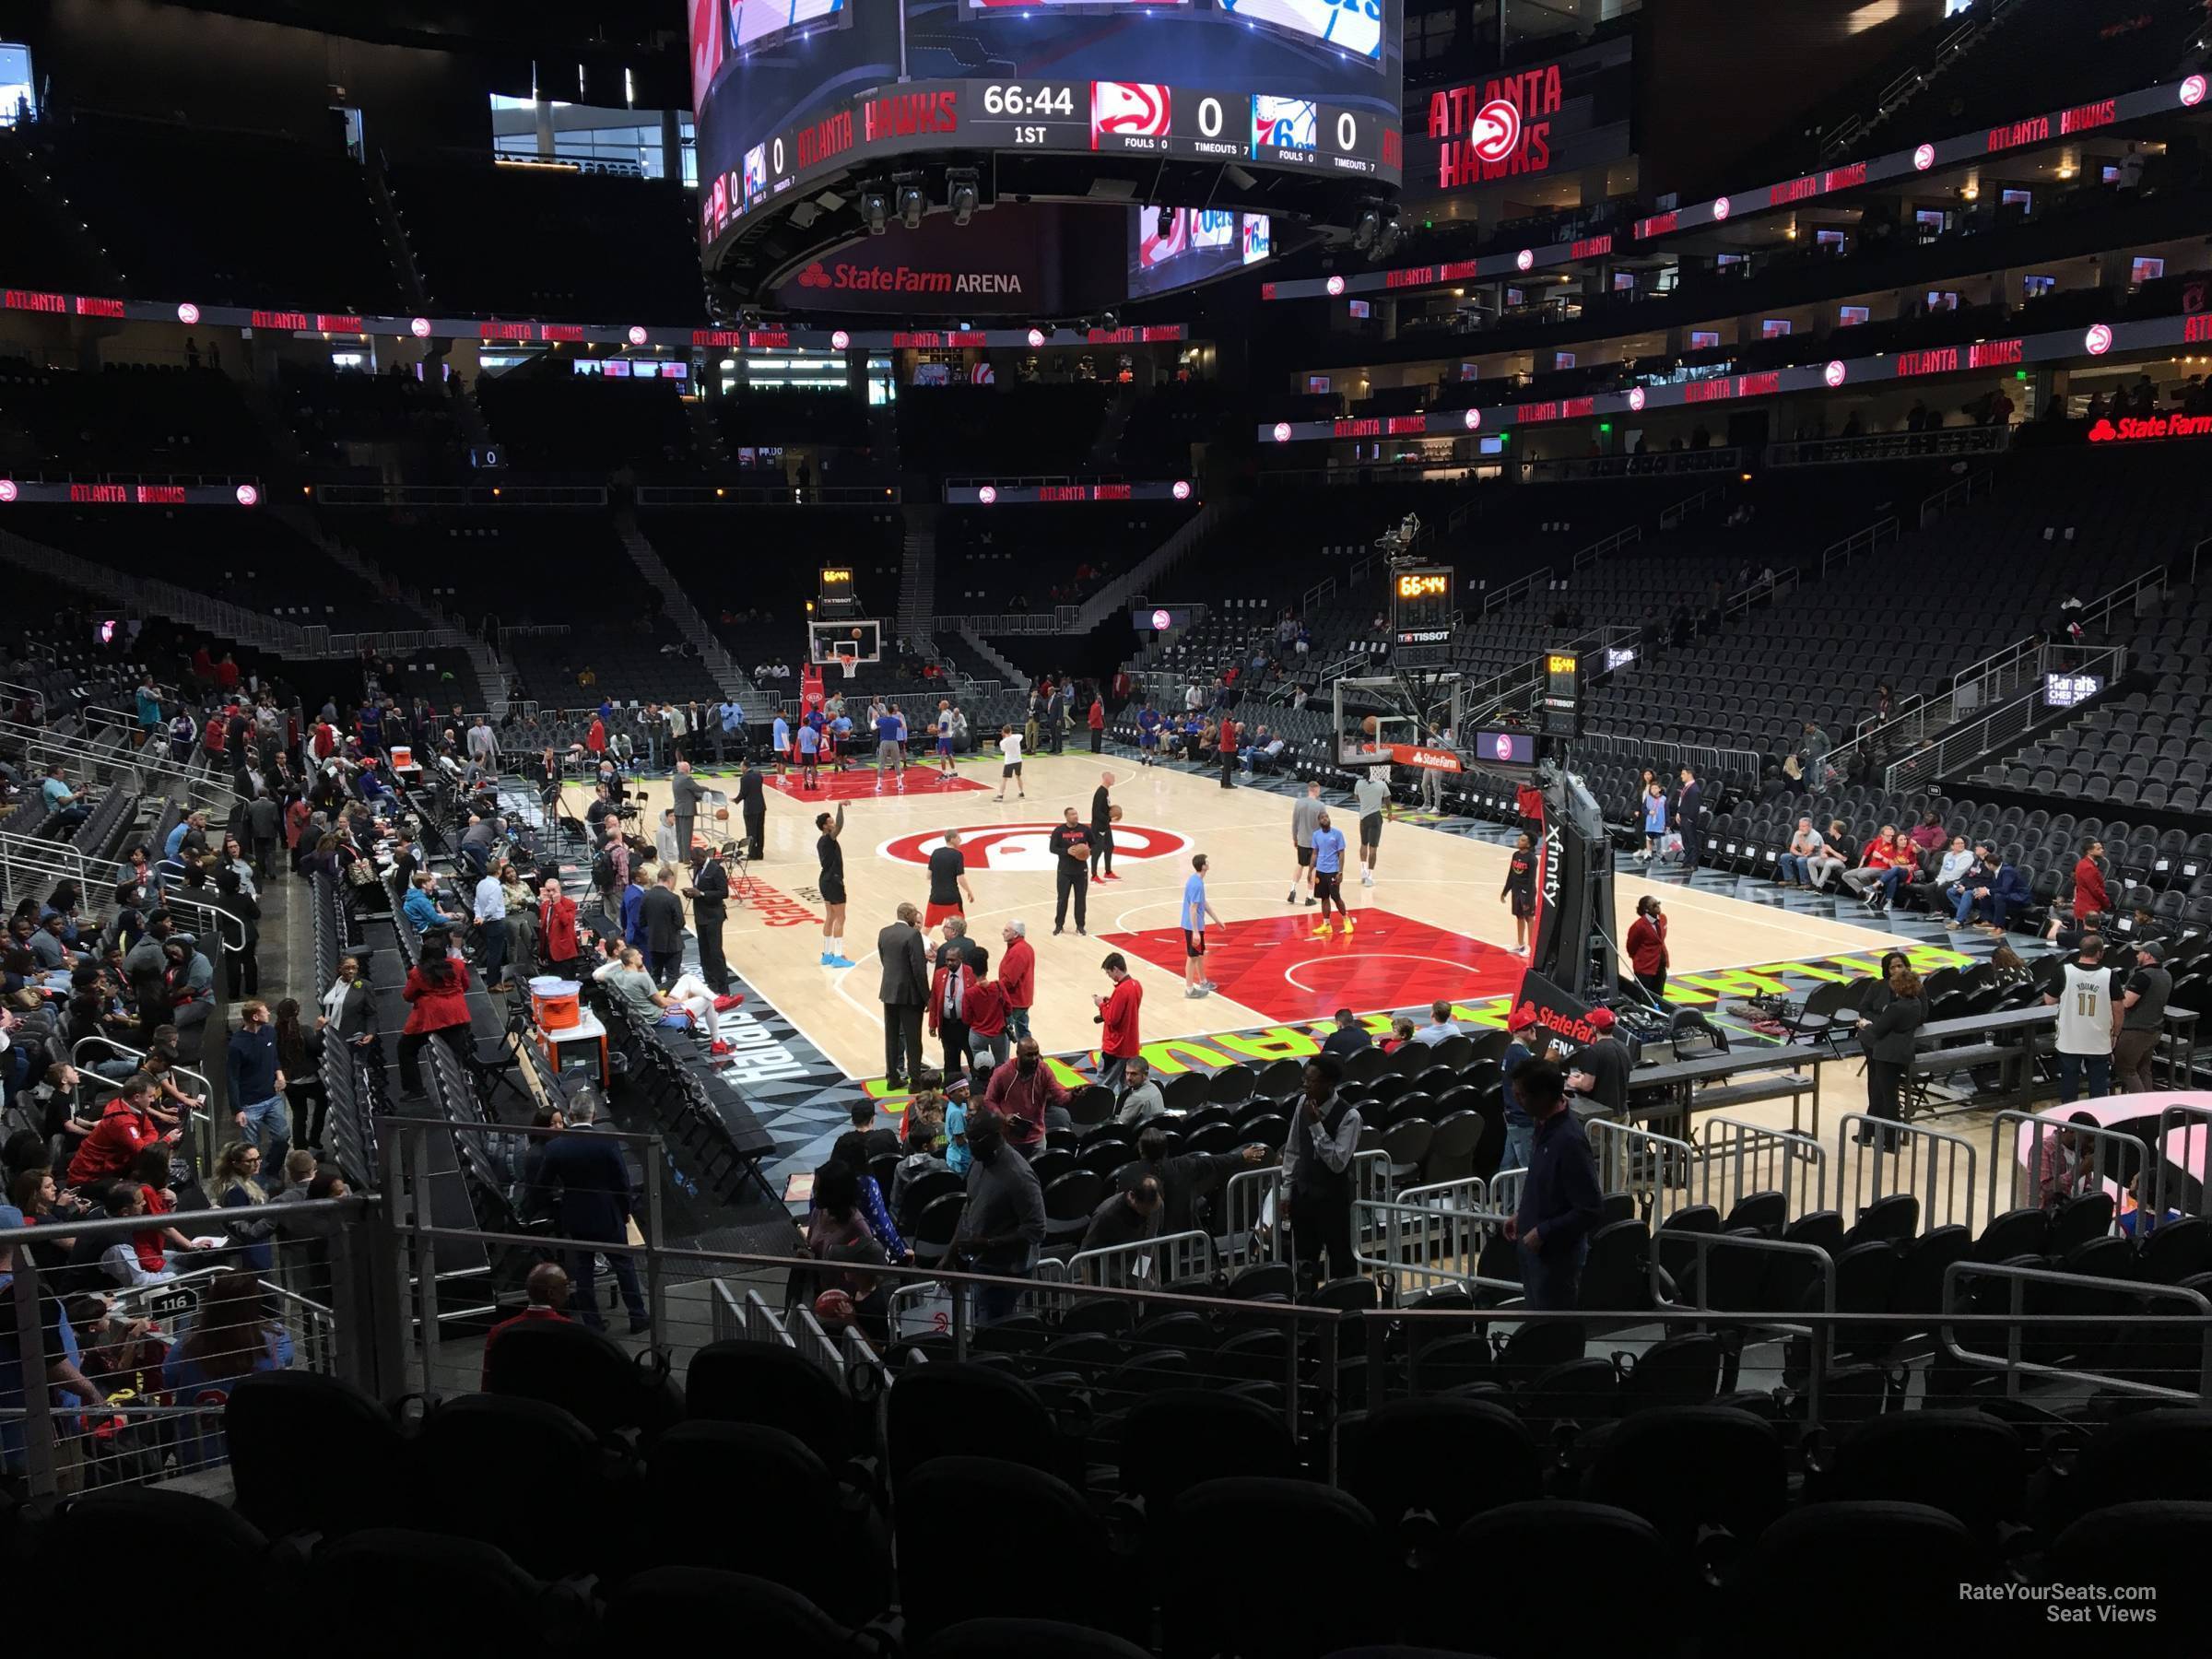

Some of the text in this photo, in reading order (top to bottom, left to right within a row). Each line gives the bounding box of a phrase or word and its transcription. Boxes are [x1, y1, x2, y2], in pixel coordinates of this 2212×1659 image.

[983, 85, 1075, 115] 66:44
[1198, 97, 1224, 137] 0
[1988, 100, 2116, 152] ATLANTA HAWKS
[798, 90, 958, 171] ATLANTA HAWKS
[1015, 126, 1047, 143] 1ST
[1337, 112, 1357, 151] 0
[1124, 137, 1169, 149] FOULS 0
[1194, 142, 1250, 156] TIMEOUTS 7
[774, 137, 783, 175] 0
[1279, 149, 1314, 163] FOULS 0
[1335, 158, 1375, 172] TIMEOUTS 7
[1770, 176, 1818, 206] ATLANTA
[955, 274, 1022, 293] ARENA
[1387, 266, 1433, 288] ATLANTA
[5, 289, 125, 318] ATLANTA HAWKS
[251, 310, 363, 334] ATLANTA HAWKS
[479, 323, 532, 340] ATLANTA
[692, 330, 789, 347] ATLANTA HAWKS
[892, 332, 986, 348] ATLANTA HAWKS
[1142, 325, 1181, 343] HAWKS
[1897, 339, 2023, 377] ATLANTA HAWKS
[1685, 371, 1780, 404] ATLANTA HAWKS
[1334, 418, 1381, 437] ATLANTA
[70, 484, 185, 504] ATLANTA HAWKS
[1040, 485, 1131, 501] ATLANTA HAWKS
[1400, 576, 1446, 596] 66:44
[1414, 630, 1451, 641] TISSOT
[1549, 655, 1576, 673] 66:44
[2049, 674, 2098, 692] Harah's
[1541, 823, 1565, 908] xfinity
[2076, 982, 2100, 994] YOUNG
[2077, 993, 2097, 1018] 11
[160, 1295, 188, 1312] 116
